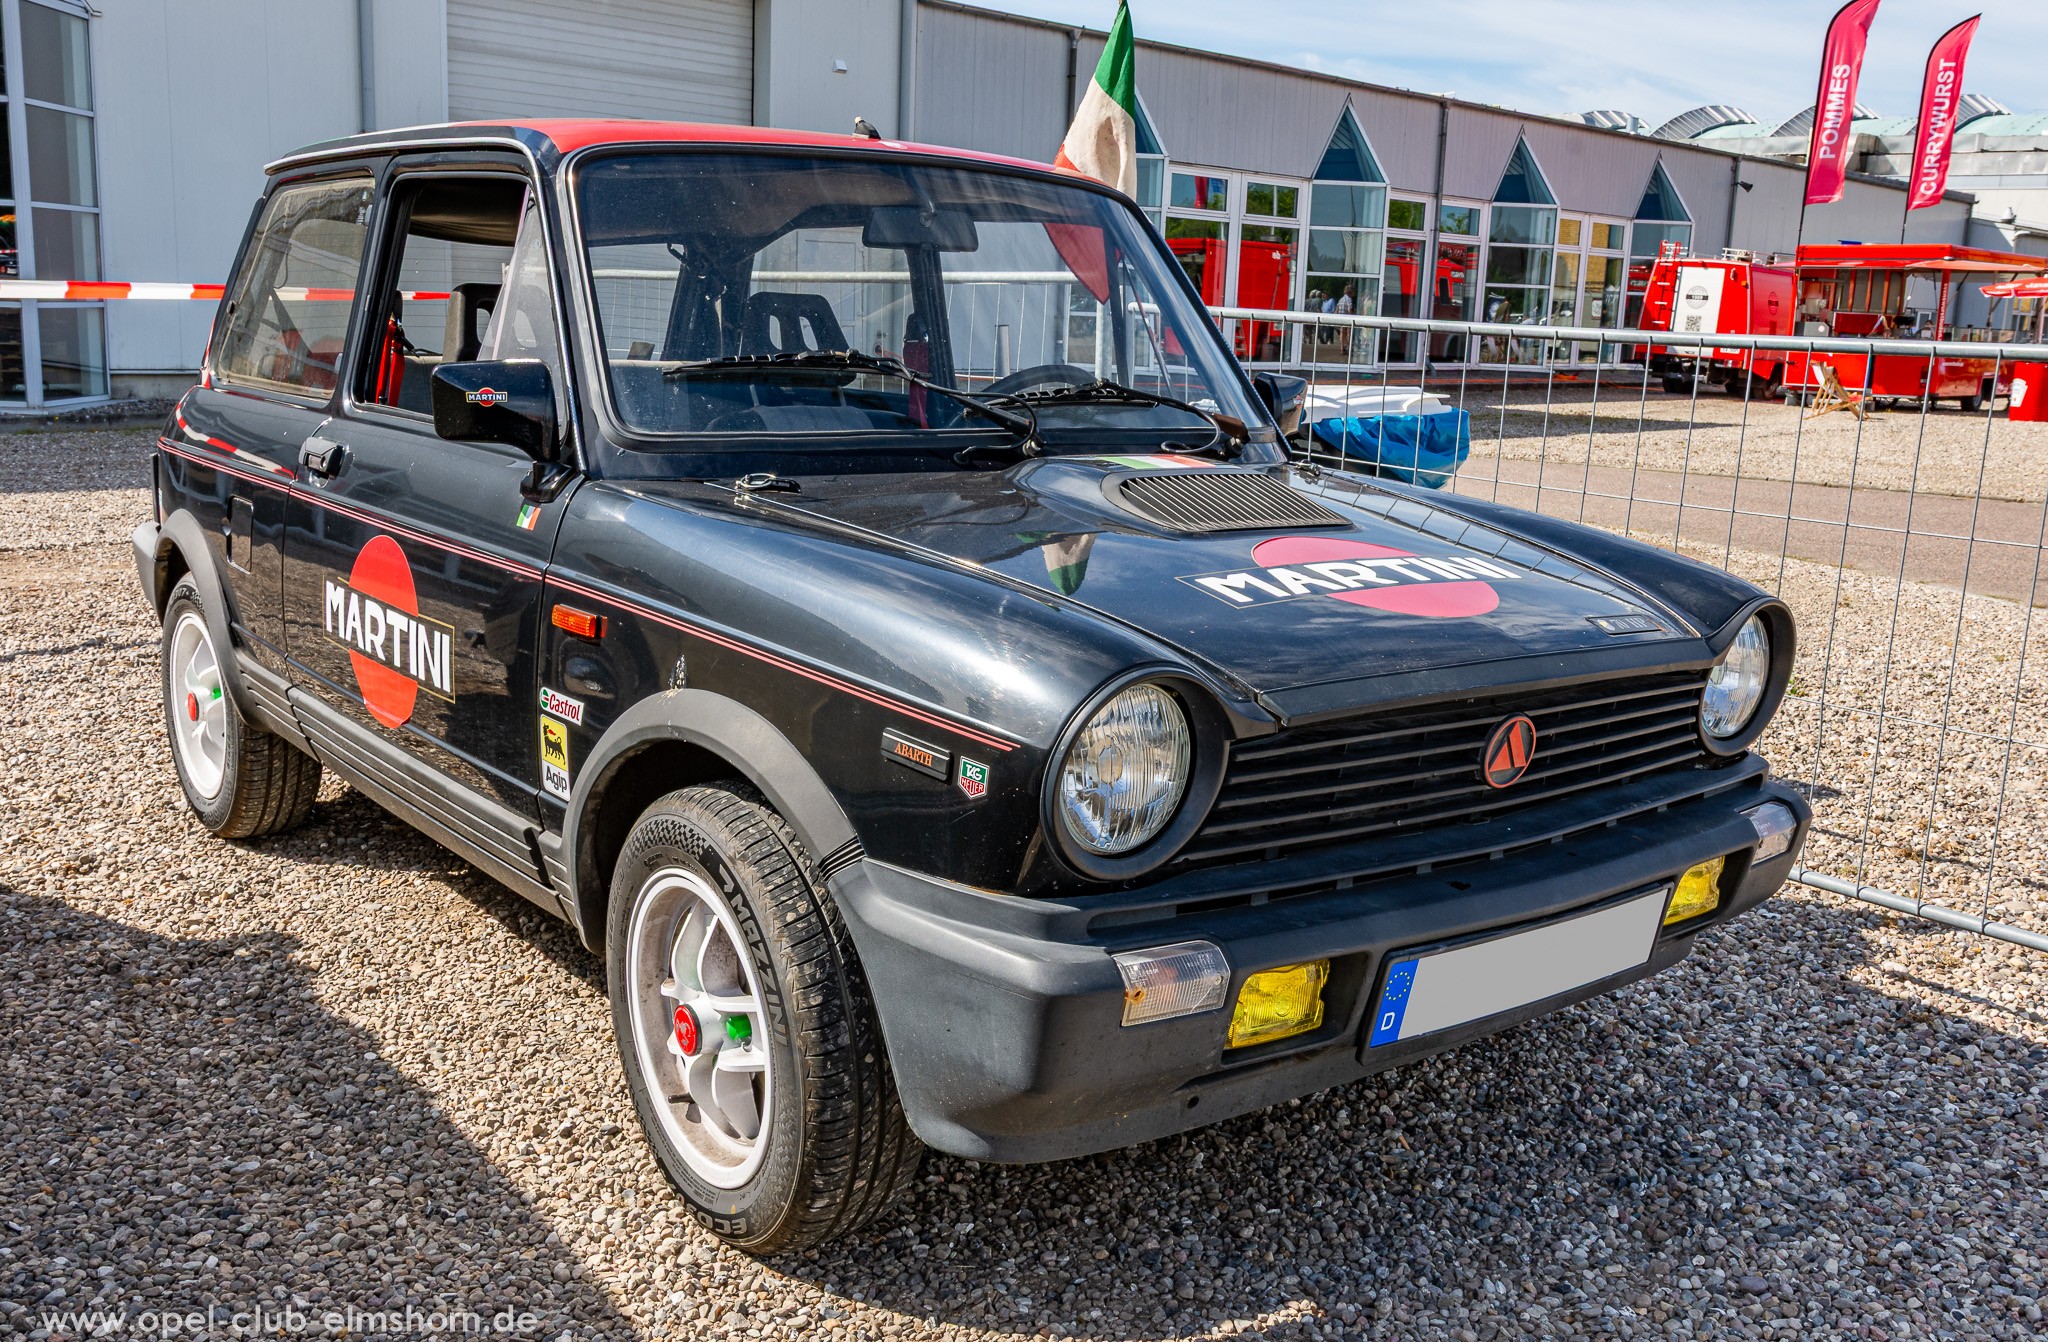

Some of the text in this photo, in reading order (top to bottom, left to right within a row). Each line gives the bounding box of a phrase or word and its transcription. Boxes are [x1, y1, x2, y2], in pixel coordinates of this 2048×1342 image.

[1819, 64, 1851, 159] POMMES
[1920, 58, 1957, 195] CURRYWURST
[468, 393, 506, 401] MARTINI
[1195, 556, 1523, 603] MARTINI
[325, 580, 451, 693] MARTINI
[549, 693, 581, 721] Castrol
[894, 742, 934, 768] ABARTH
[546, 765, 568, 793] Agip
[960, 776, 985, 795] HEUER
[965, 763, 983, 781] TAG
[731, 893, 789, 1047] MAZZINI
[1380, 1011, 1396, 1031] D
